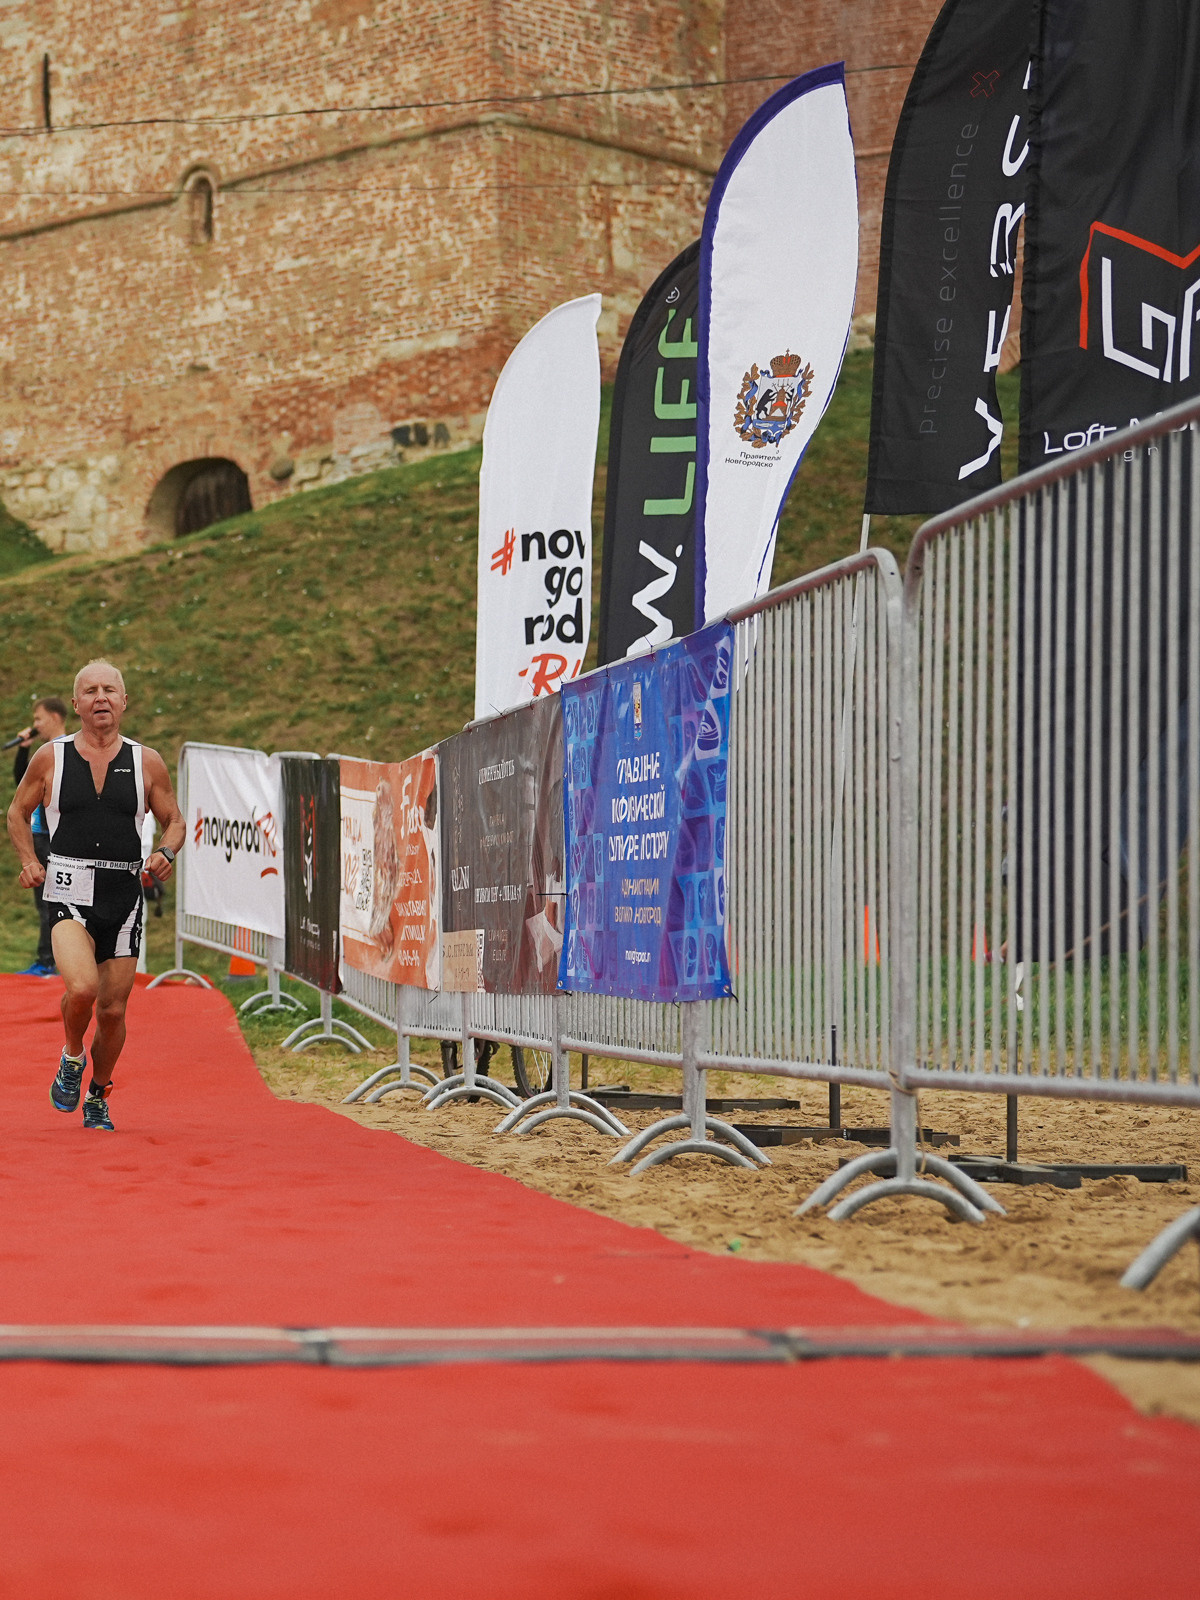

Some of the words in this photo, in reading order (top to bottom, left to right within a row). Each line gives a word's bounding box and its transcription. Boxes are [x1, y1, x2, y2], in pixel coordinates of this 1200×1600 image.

[938, 122, 980, 302] excellence
[918, 316, 954, 435] precise
[55, 871, 73, 886] 53
